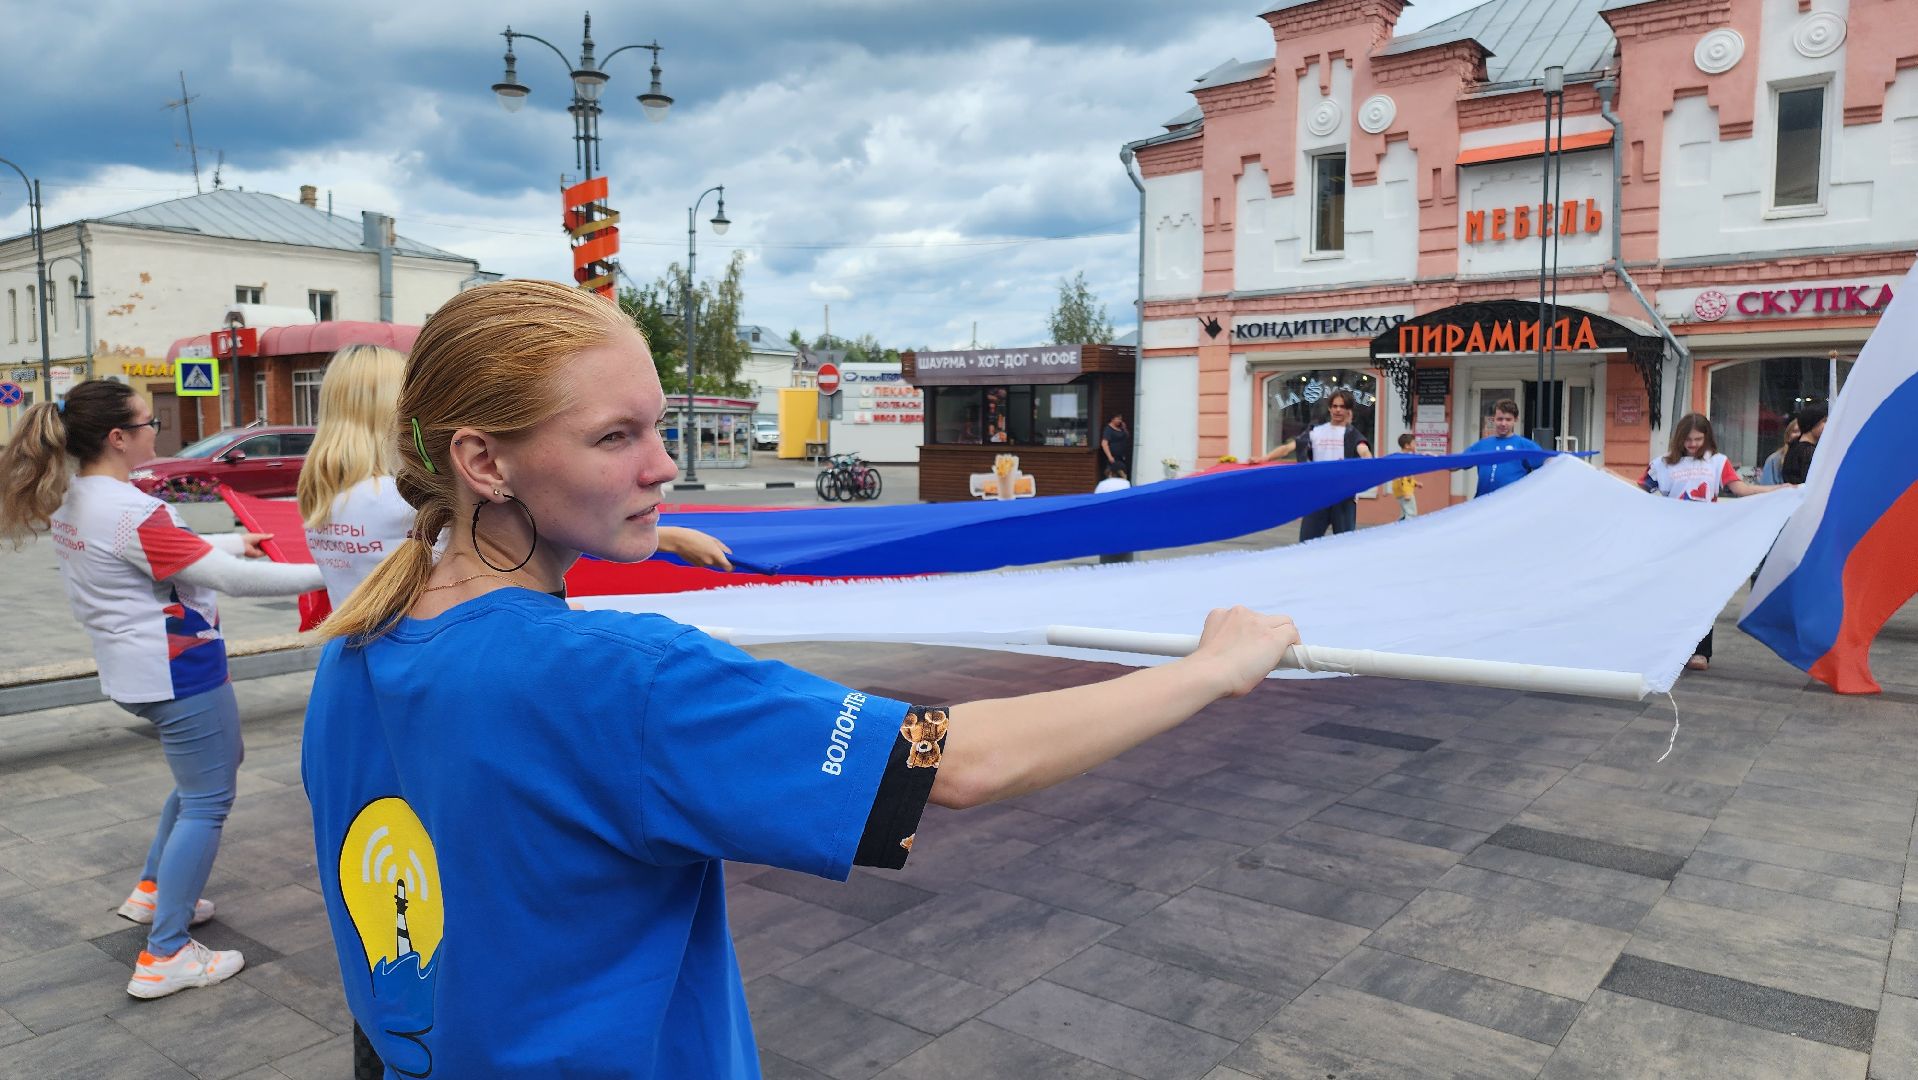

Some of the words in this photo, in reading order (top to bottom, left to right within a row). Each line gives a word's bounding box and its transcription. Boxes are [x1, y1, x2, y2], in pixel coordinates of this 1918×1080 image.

[1465, 198, 1603, 244] МЕБЕЛЬ
[1236, 315, 1405, 339] КОНДИТЕРСКАЯ
[1399, 315, 1601, 354] ПИРАМИДА
[918, 355, 967, 370] ШАУРМА
[977, 353, 1030, 369] ХОТ-ДОГ
[1041, 351, 1078, 366] КОФЕ
